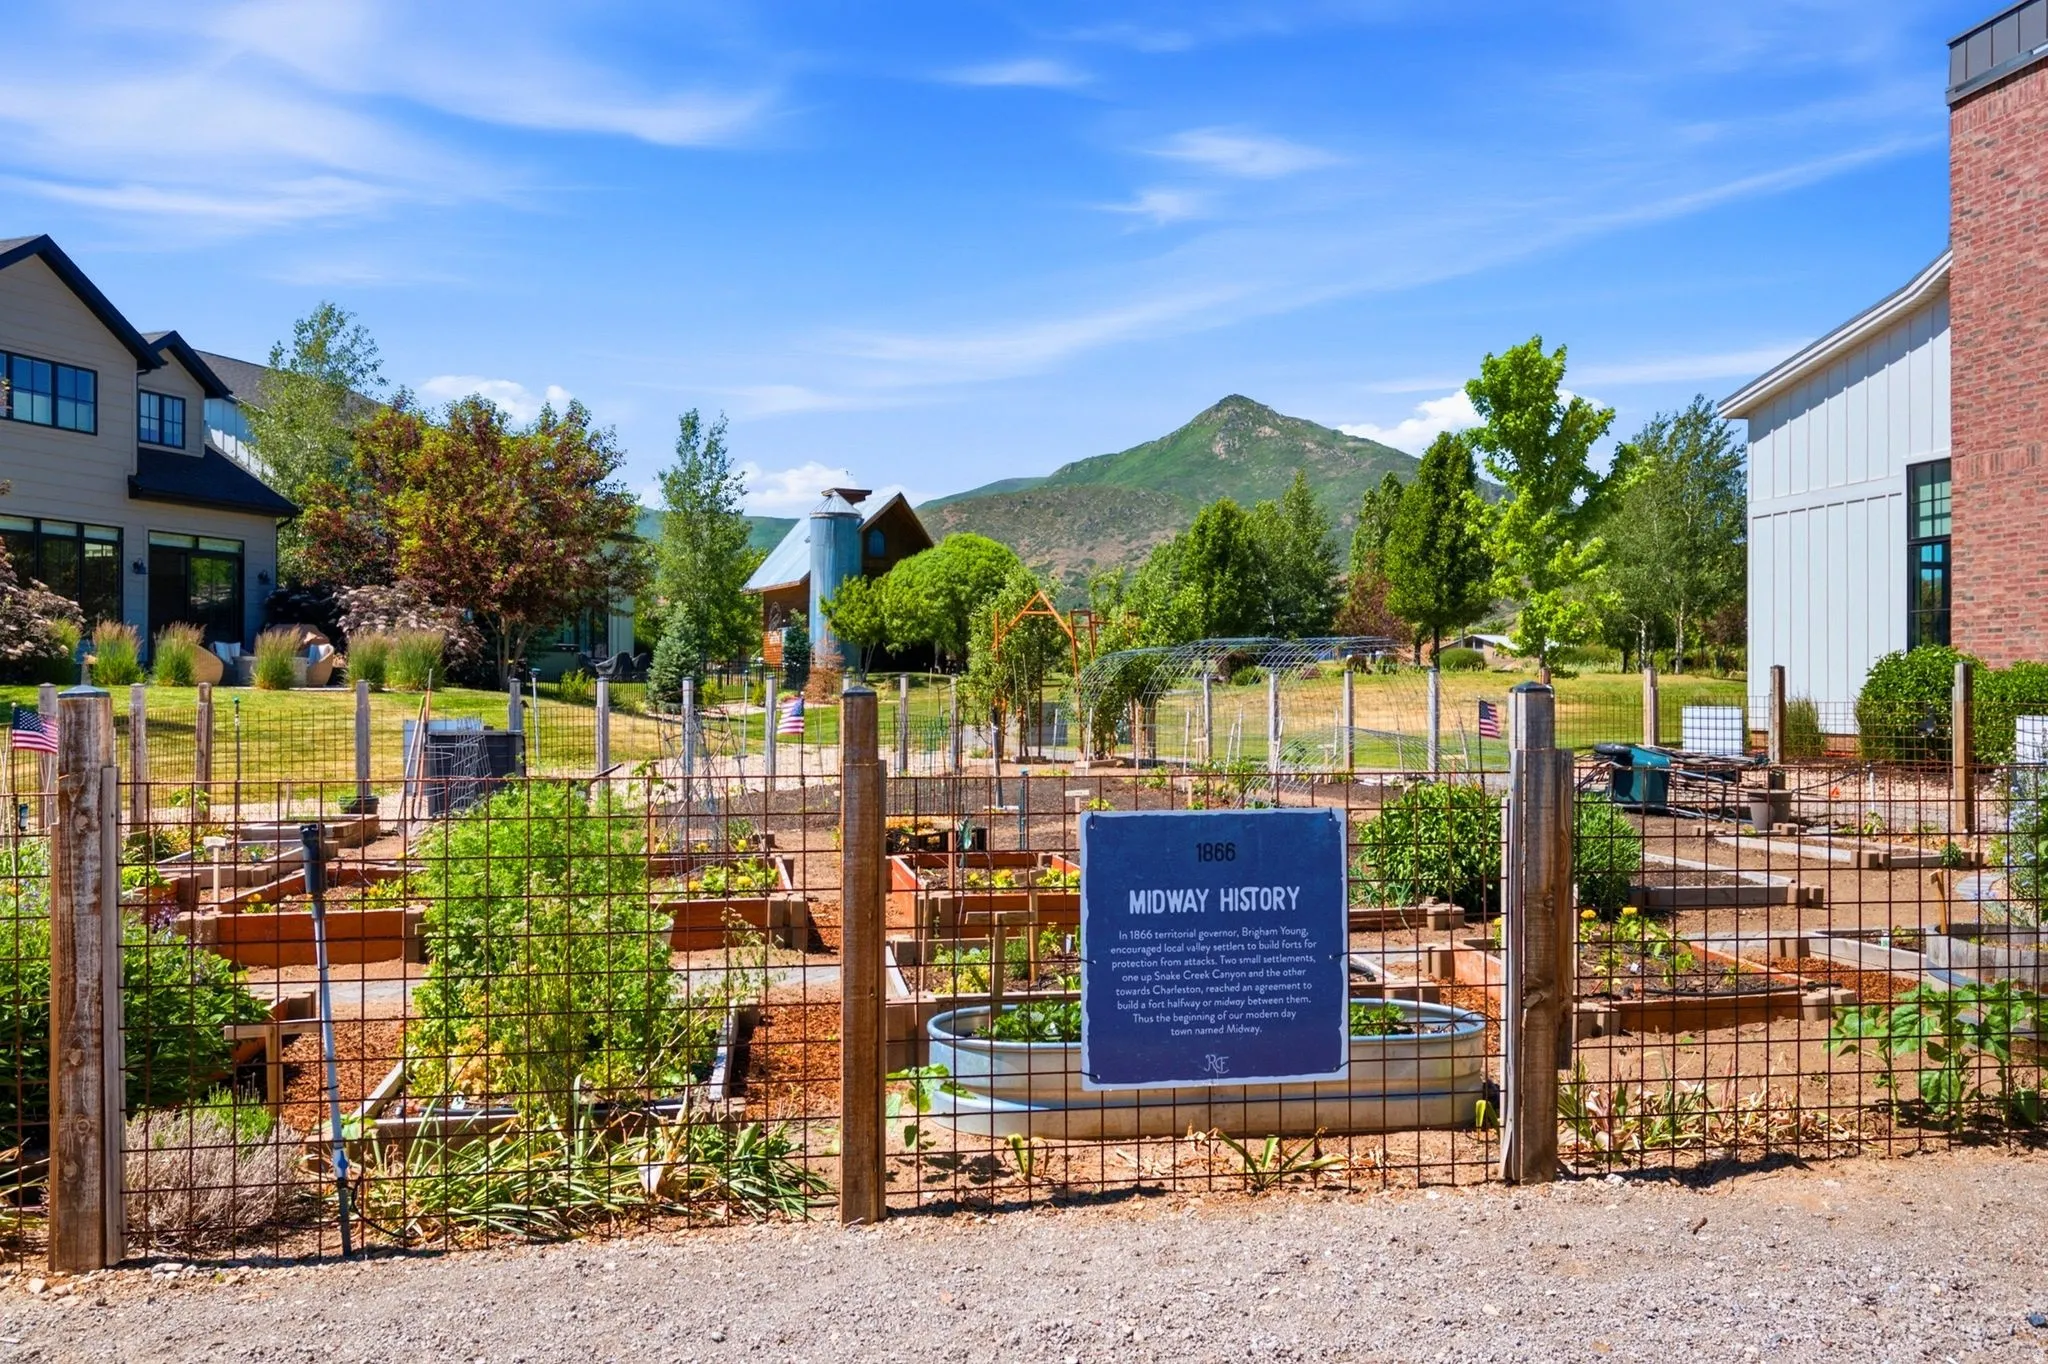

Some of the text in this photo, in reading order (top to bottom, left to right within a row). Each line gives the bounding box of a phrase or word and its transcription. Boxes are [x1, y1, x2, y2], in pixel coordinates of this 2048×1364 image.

[1195, 842, 1236, 862] 1866
[1129, 886, 1300, 915] MIDWAY HISTORY
[1118, 927, 1309, 941] In 1866 territorial governor, Brigham Young,
[1110, 940, 1317, 956] encouraged local valley settlers to build forts for
[1111, 954, 1316, 971] protection from attacks. Two small settlements,
[1122, 967, 1306, 984] one up Snake Creek Canyon and the other
[1115, 982, 1312, 996] towards Charleston, reached an agreement to
[1117, 1000, 1138, 1010] build
[1148, 999, 1165, 1009] fort
[1167, 998, 1200, 1011] halfway
[1214, 997, 1245, 1008] midway
[1247, 996, 1284, 1006] between
[1286, 995, 1311, 1004] them.
[1133, 1009, 1296, 1024] Thus the beginning of our modern day
[1171, 1024, 1262, 1036] town named Midway.
